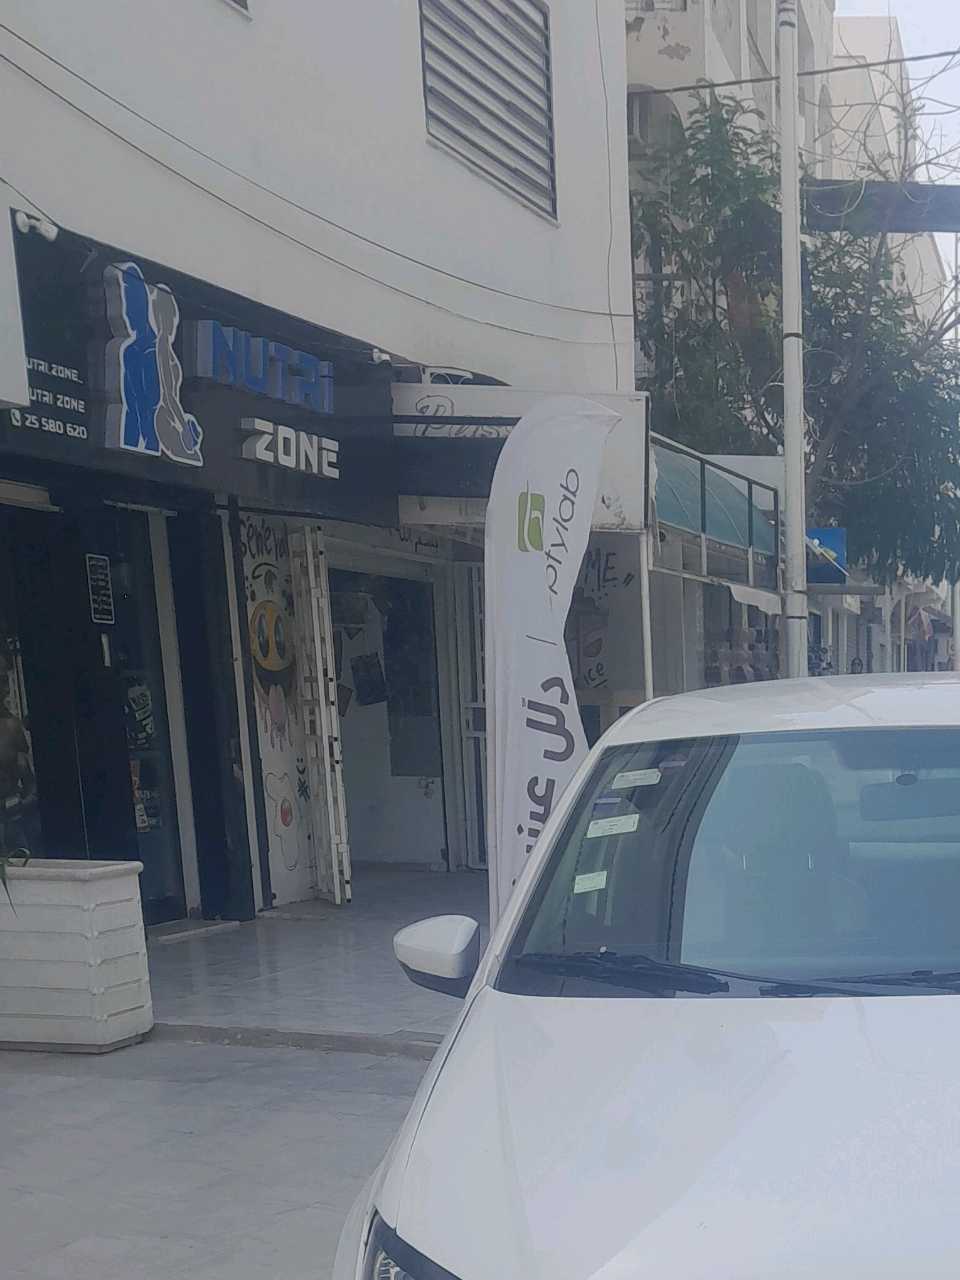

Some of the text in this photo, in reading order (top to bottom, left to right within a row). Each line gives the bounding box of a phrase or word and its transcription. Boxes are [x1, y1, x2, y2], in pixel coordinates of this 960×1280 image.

[29, 386, 86, 413] UTRI ZONE
[24, 413, 88, 439] 25 580 620
[242, 417, 340, 480] ZONE
